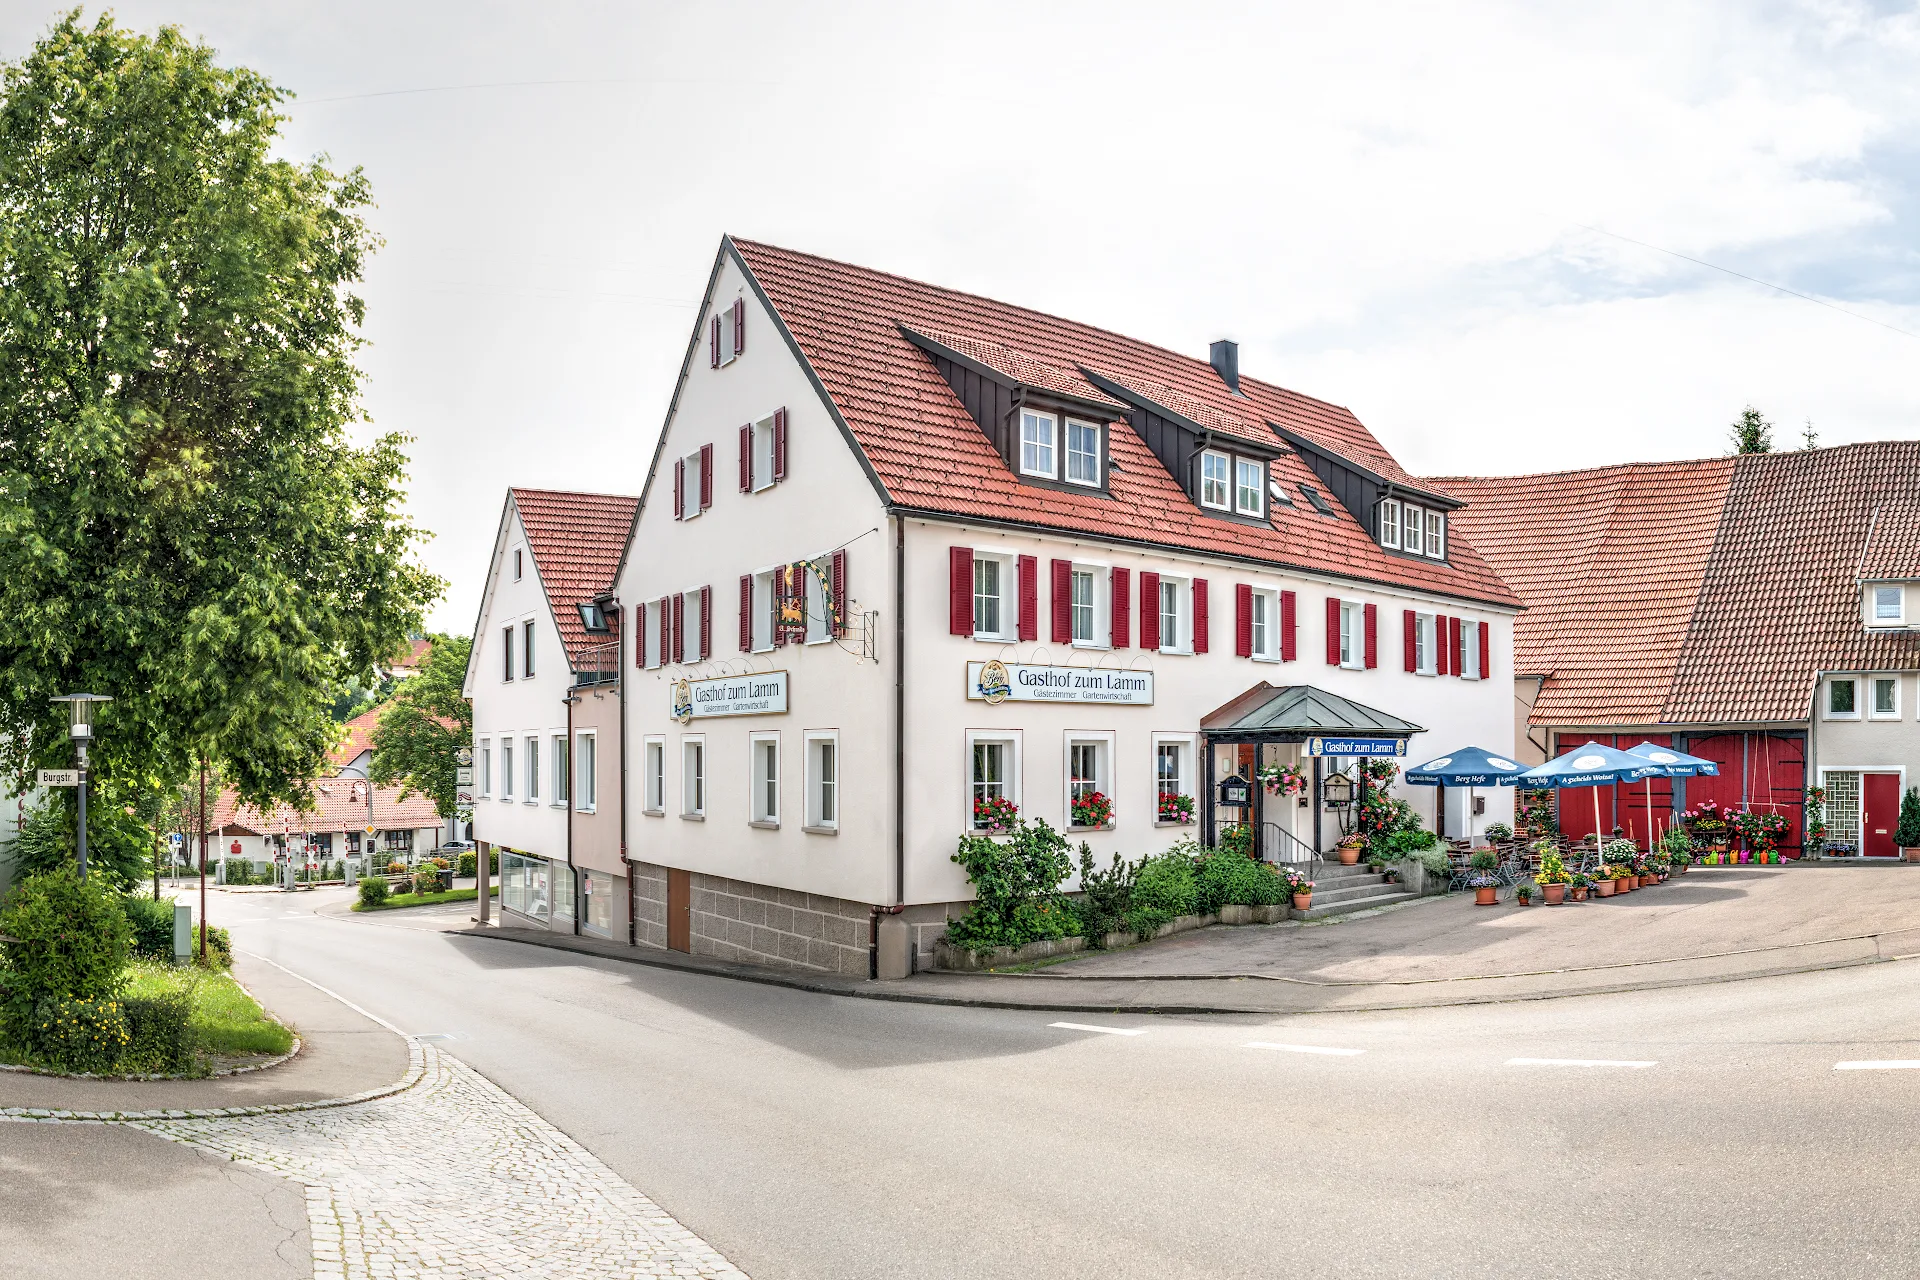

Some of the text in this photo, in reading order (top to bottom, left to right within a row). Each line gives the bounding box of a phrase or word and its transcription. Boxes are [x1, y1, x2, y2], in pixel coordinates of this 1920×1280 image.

[1018, 669, 1146, 691] Gasthof zum Lamm
[695, 681, 779, 703] Gasthof zum Lamm
[1033, 688, 1132, 701] Gästezimmer Gartenwirtschaft
[1325, 741, 1354, 753] Gasthof
[1354, 744, 1370, 753] zum
[1371, 743, 1393, 753] Lamm
[43, 772, 73, 784] Burgstr.
[1455, 775, 1486, 783] Berg Hefe
